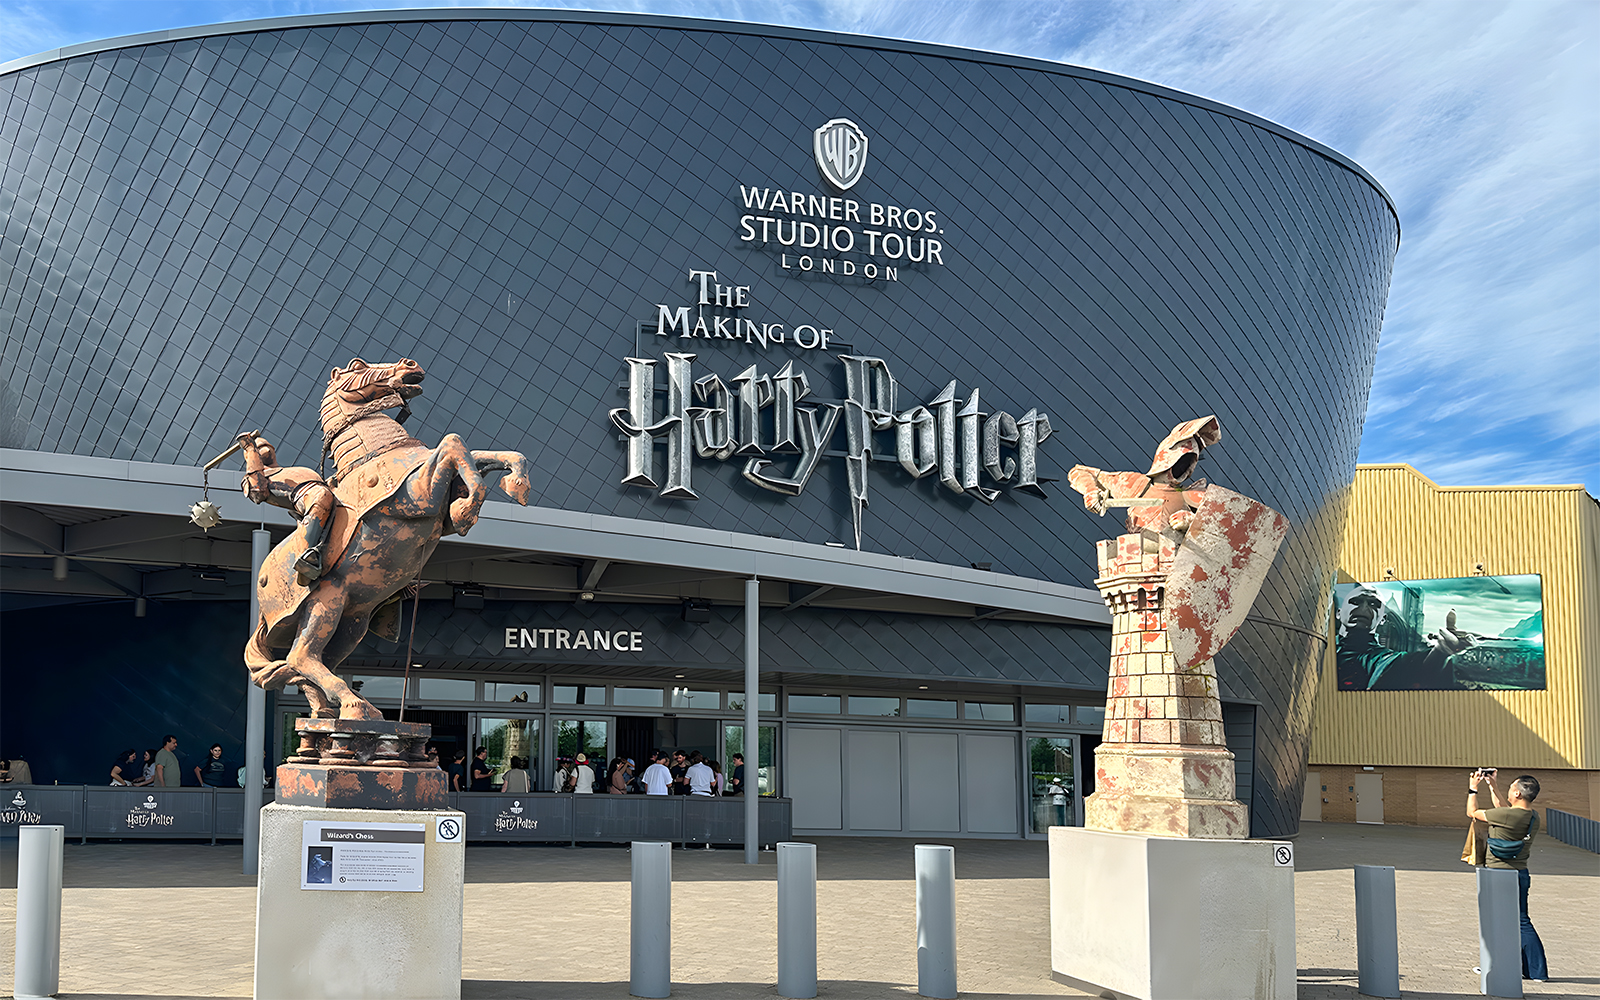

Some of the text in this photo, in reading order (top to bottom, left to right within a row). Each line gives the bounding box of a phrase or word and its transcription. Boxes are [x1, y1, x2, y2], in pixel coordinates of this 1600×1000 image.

[740, 185, 944, 235] WARNER BROS.
[740, 215, 944, 265] STUDIO TOUR
[782, 253, 899, 282] LONDON
[608, 352, 1055, 551] Harry Potter
[505, 628, 643, 651] ENTRANCE
[126, 812, 174, 828] Harry Potter
[494, 818, 517, 832] Harry
